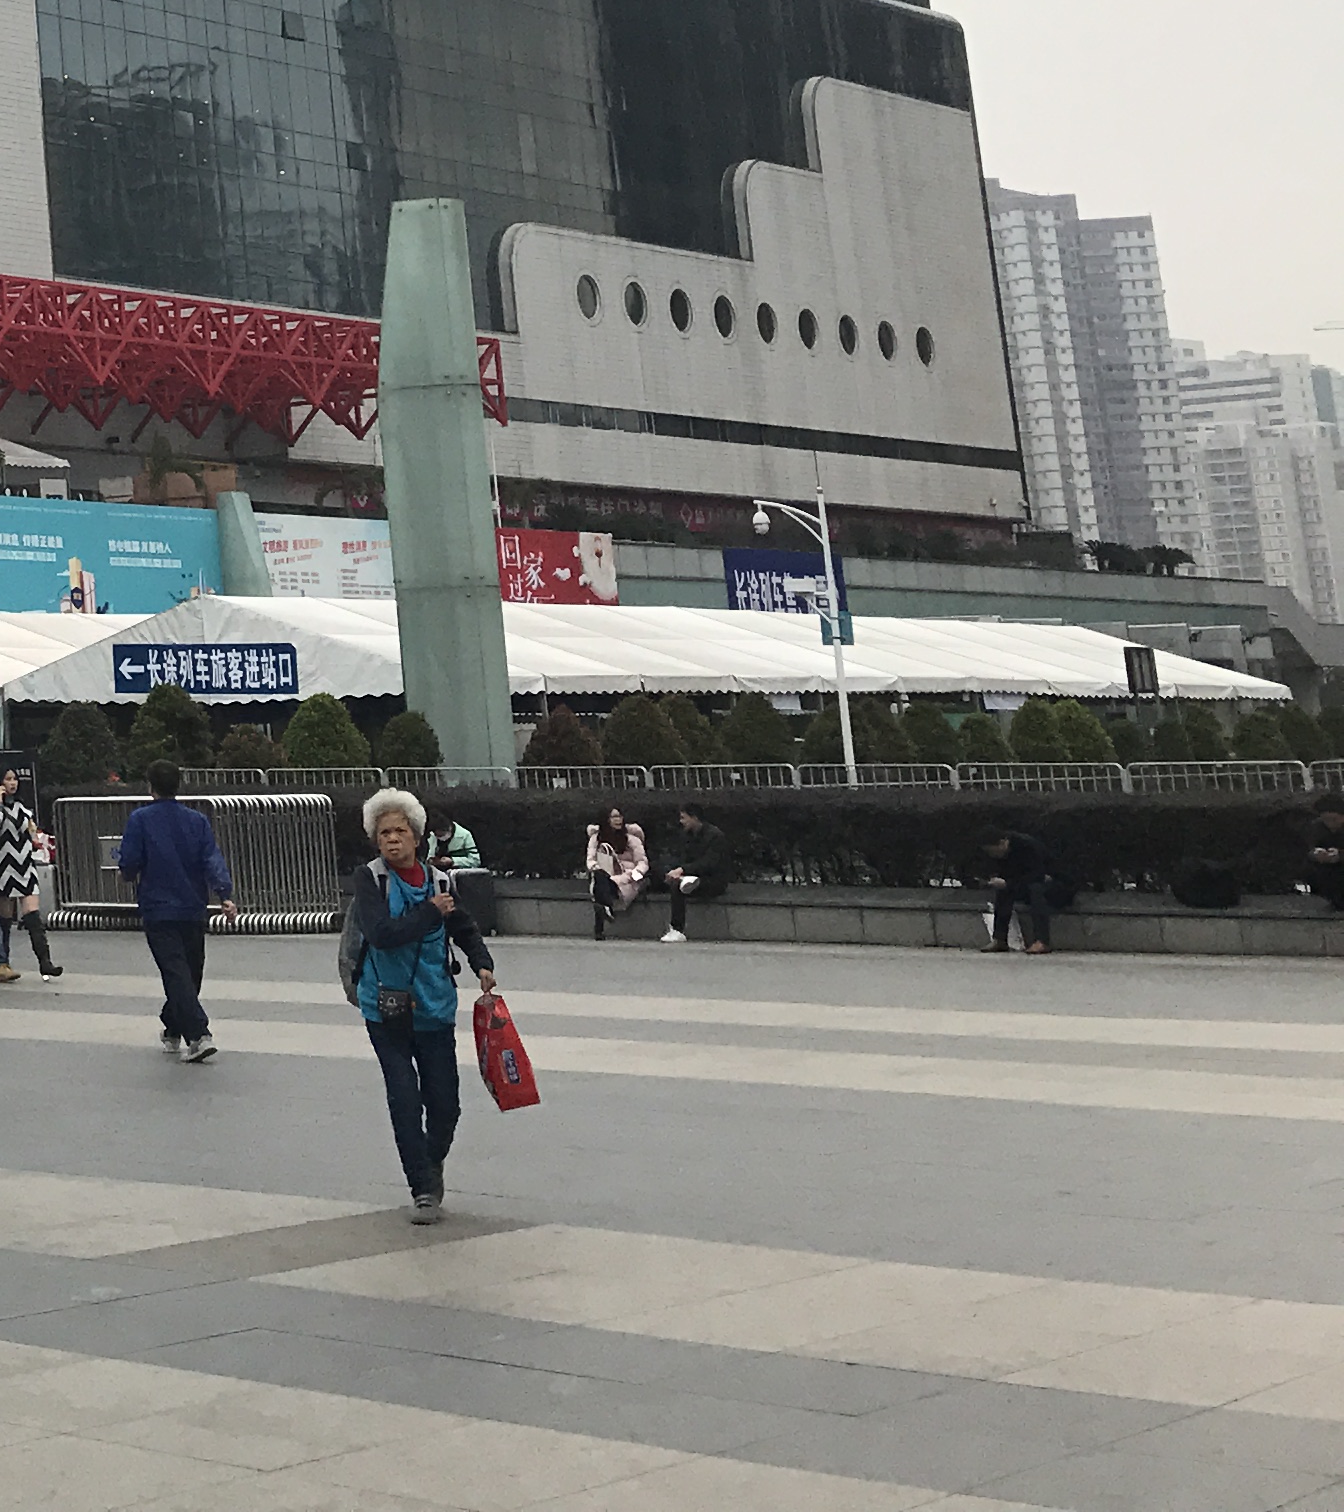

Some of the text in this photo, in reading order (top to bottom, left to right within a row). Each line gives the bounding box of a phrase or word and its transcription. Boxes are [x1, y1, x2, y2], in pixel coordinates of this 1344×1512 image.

[146, 648, 293, 690] 长途列车旅客进站口
